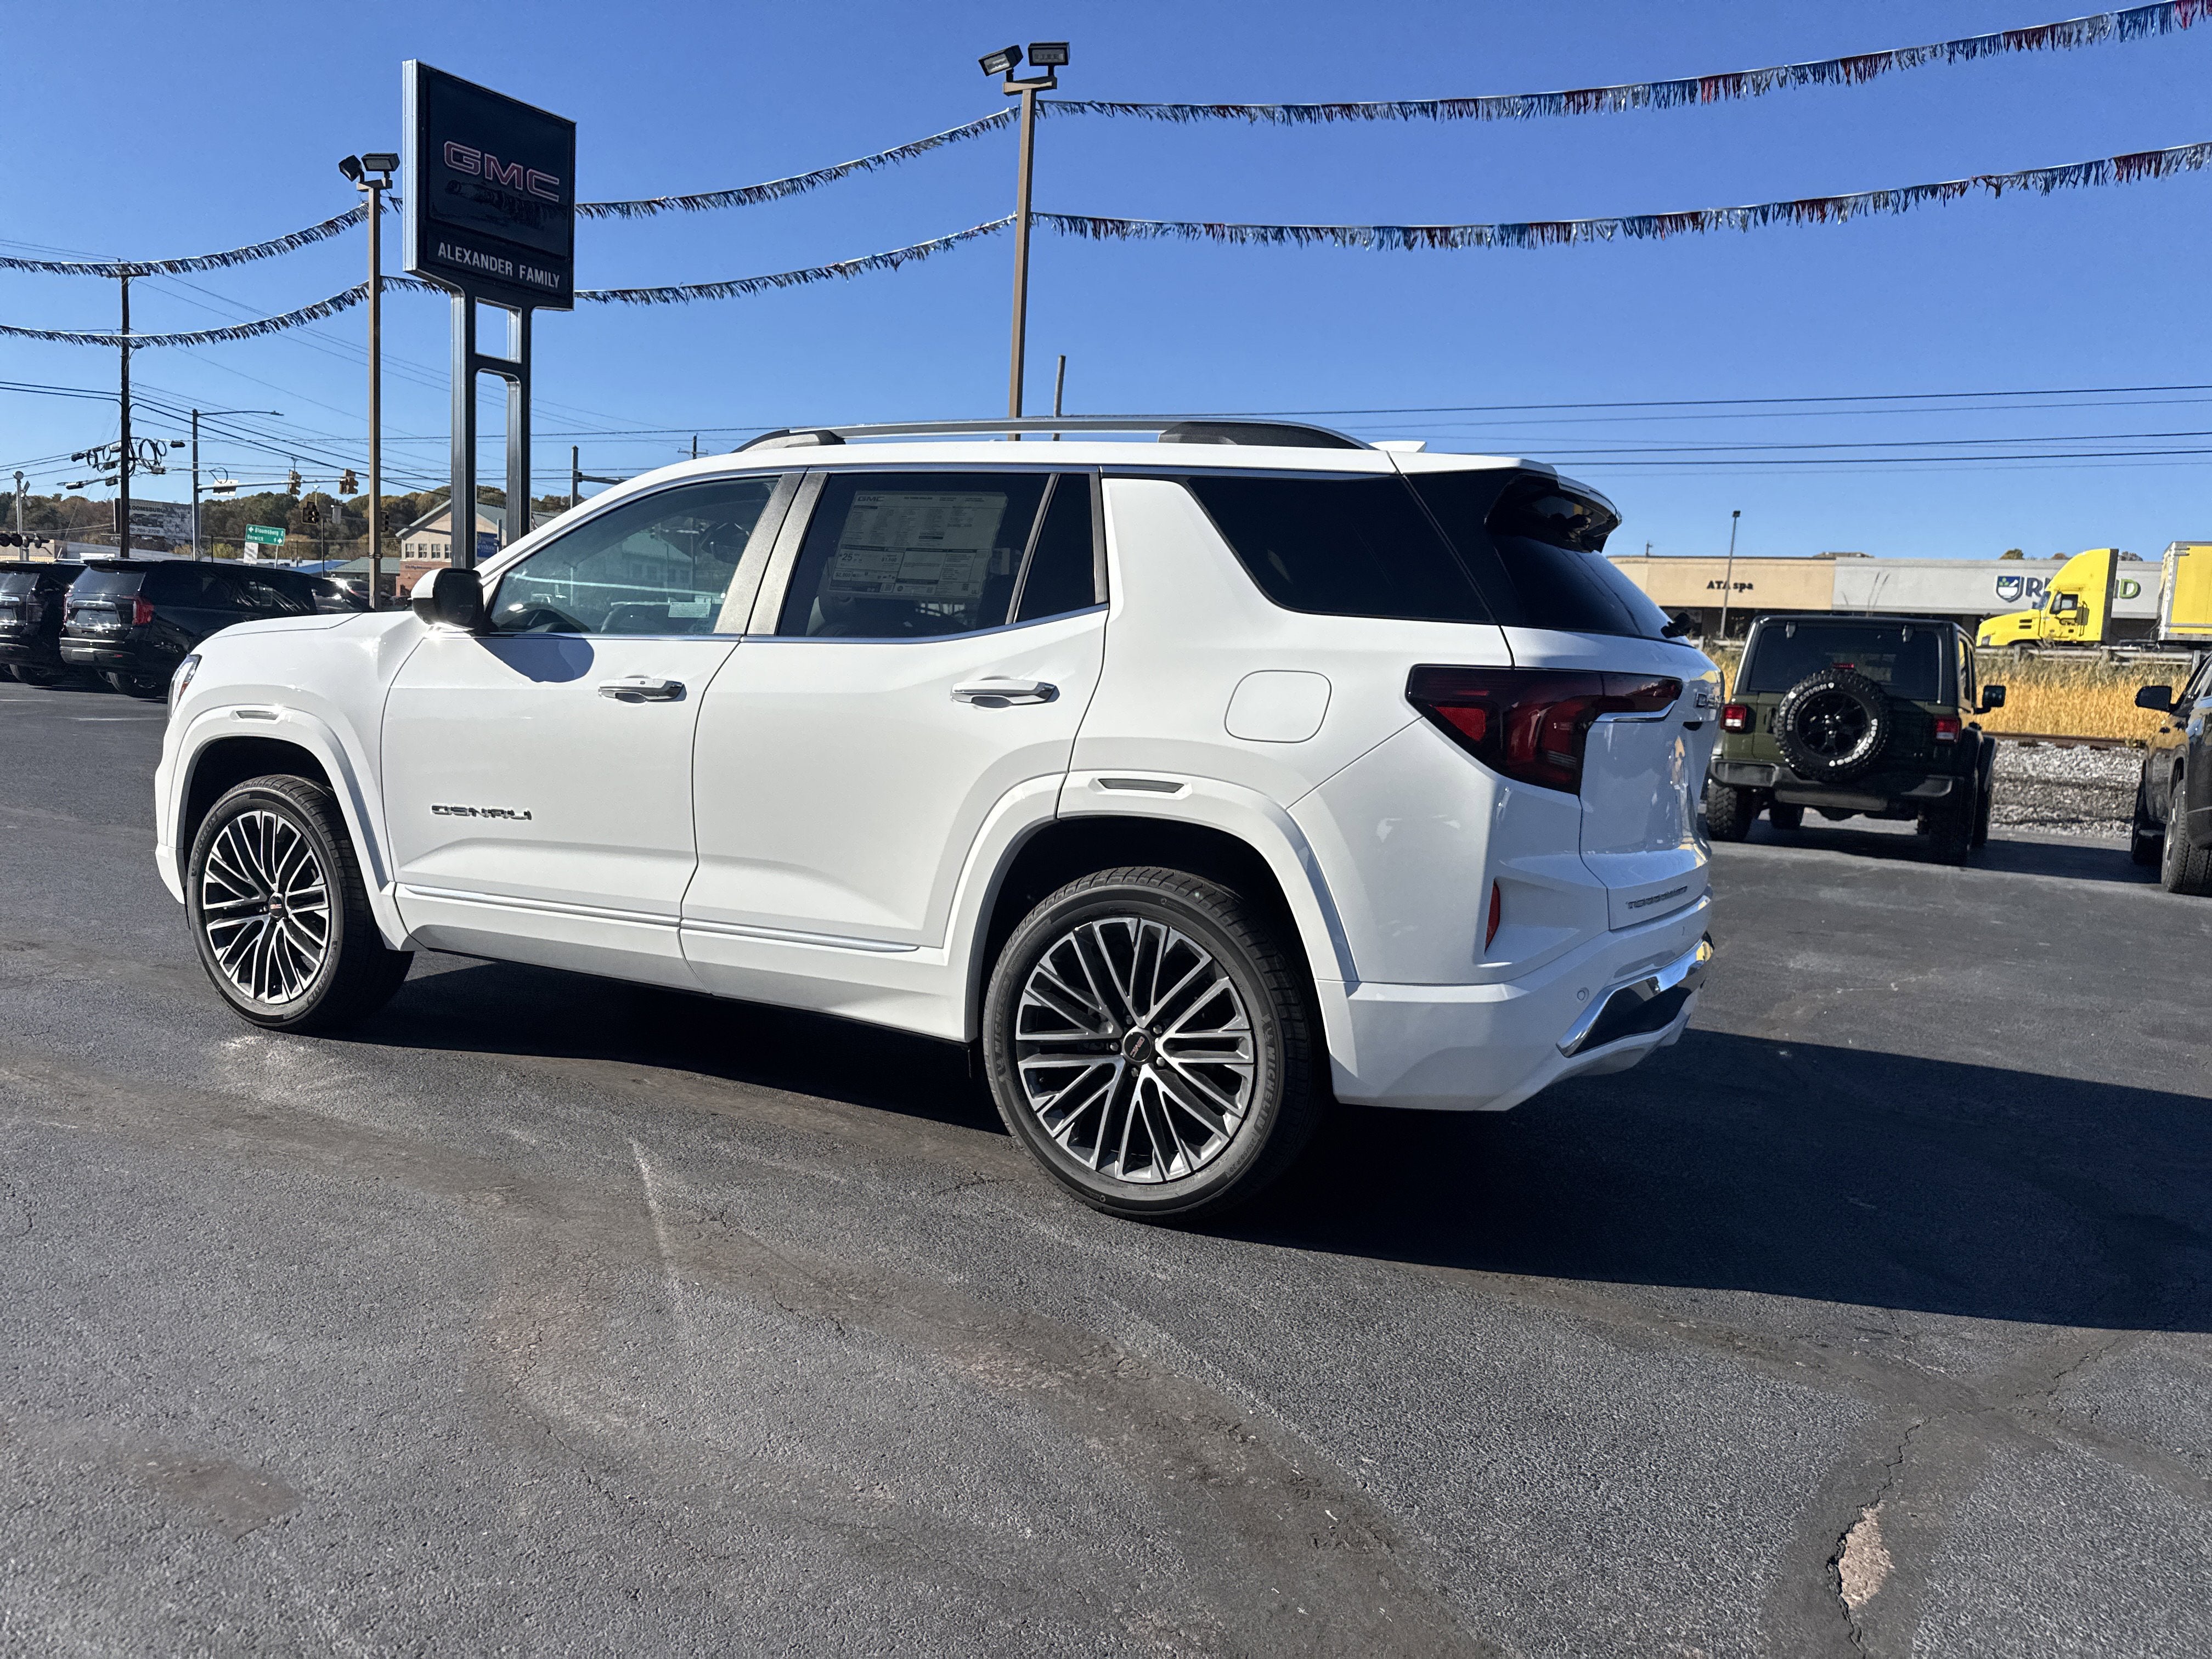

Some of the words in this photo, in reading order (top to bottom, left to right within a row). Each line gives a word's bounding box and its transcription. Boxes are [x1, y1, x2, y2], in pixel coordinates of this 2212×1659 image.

[444, 140, 560, 202] GMC
[438, 242, 513, 277] ALEXANDER
[519, 264, 560, 289] FAMILY
[1733, 582, 1753, 592] spa
[432, 805, 532, 821] DENALI
[994, 977, 1011, 1054] MICHELIN
[1257, 1045, 1276, 1130] MICHELIN
